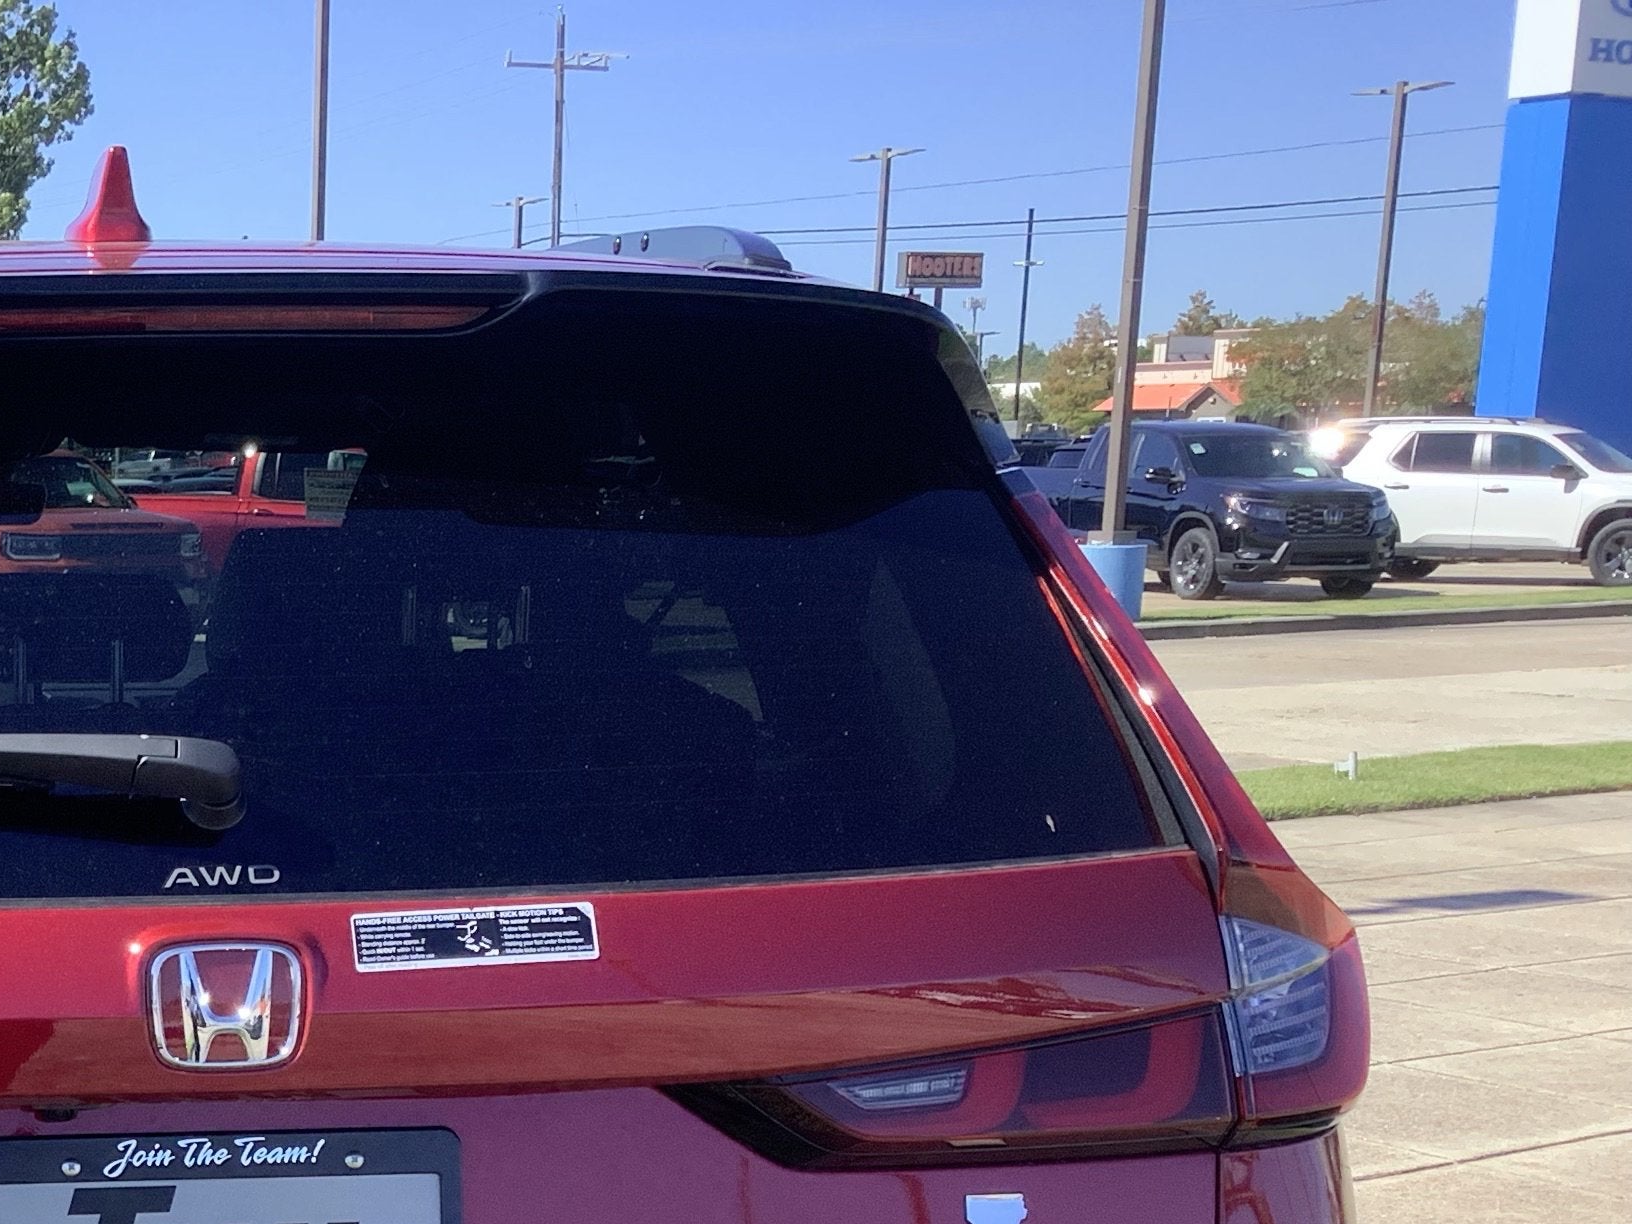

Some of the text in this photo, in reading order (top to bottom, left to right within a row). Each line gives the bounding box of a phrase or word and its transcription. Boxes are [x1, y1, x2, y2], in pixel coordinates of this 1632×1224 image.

[163, 864, 281, 889] AWD
[103, 1136, 325, 1178] Join The Team!
